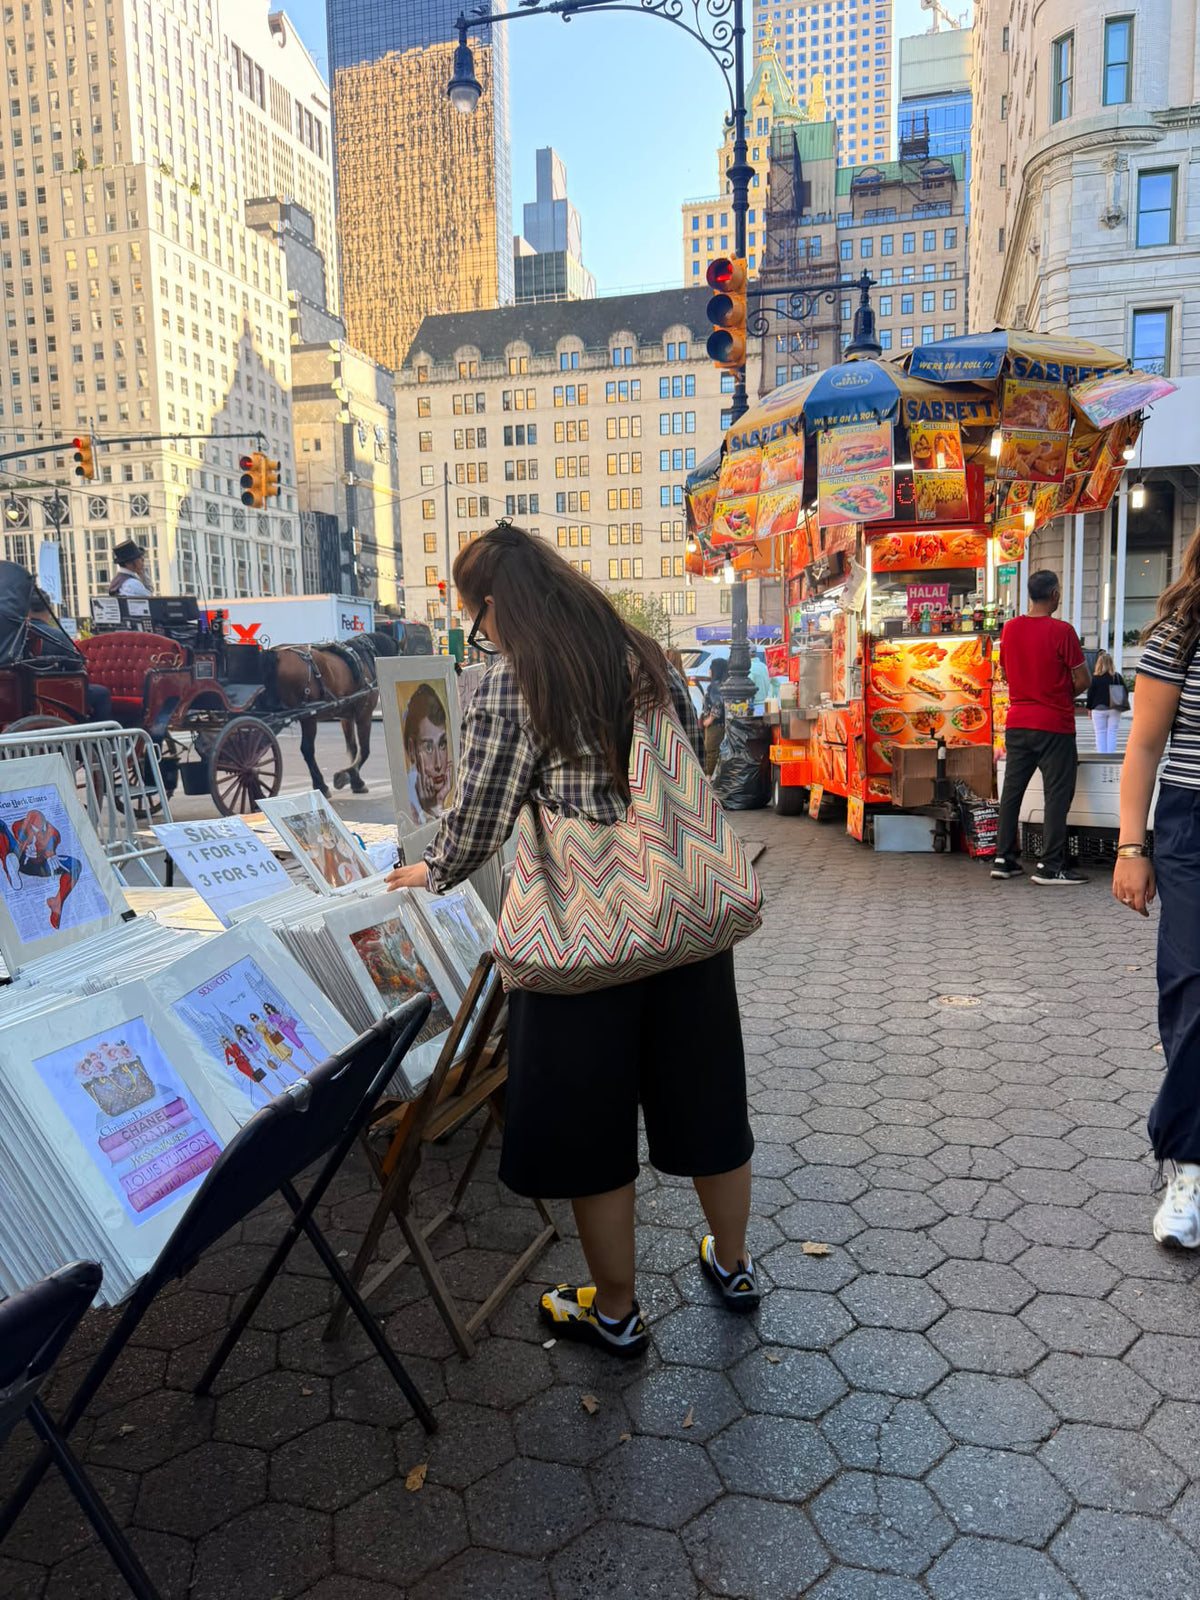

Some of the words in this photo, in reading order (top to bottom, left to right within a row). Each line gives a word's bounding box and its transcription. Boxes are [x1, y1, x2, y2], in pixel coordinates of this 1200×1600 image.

[944, 361, 955, 370] ON
[962, 361, 981, 369] ROLL
[840, 415, 850, 423] ON
[852, 414, 858, 422] A
[907, 400, 994, 421] SABRETT
[909, 586, 946, 598] HALAL
[912, 602, 942, 613] FOOD
[341, 614, 365, 632] FedEx
[12, 798, 29, 809] York
[27, 795, 47, 804] Times
[183, 824, 237, 843] SALE
[187, 850, 199, 863] 1
[200, 844, 235, 861] FOR
[198, 874, 211, 887] 3
[211, 867, 247, 884] FOR
[121, 1109, 173, 1141] CHANEL
[130, 1121, 176, 1150] PRADA
[126, 1162, 161, 1191] LOUIS
[160, 1135, 210, 1169] VUITTON
